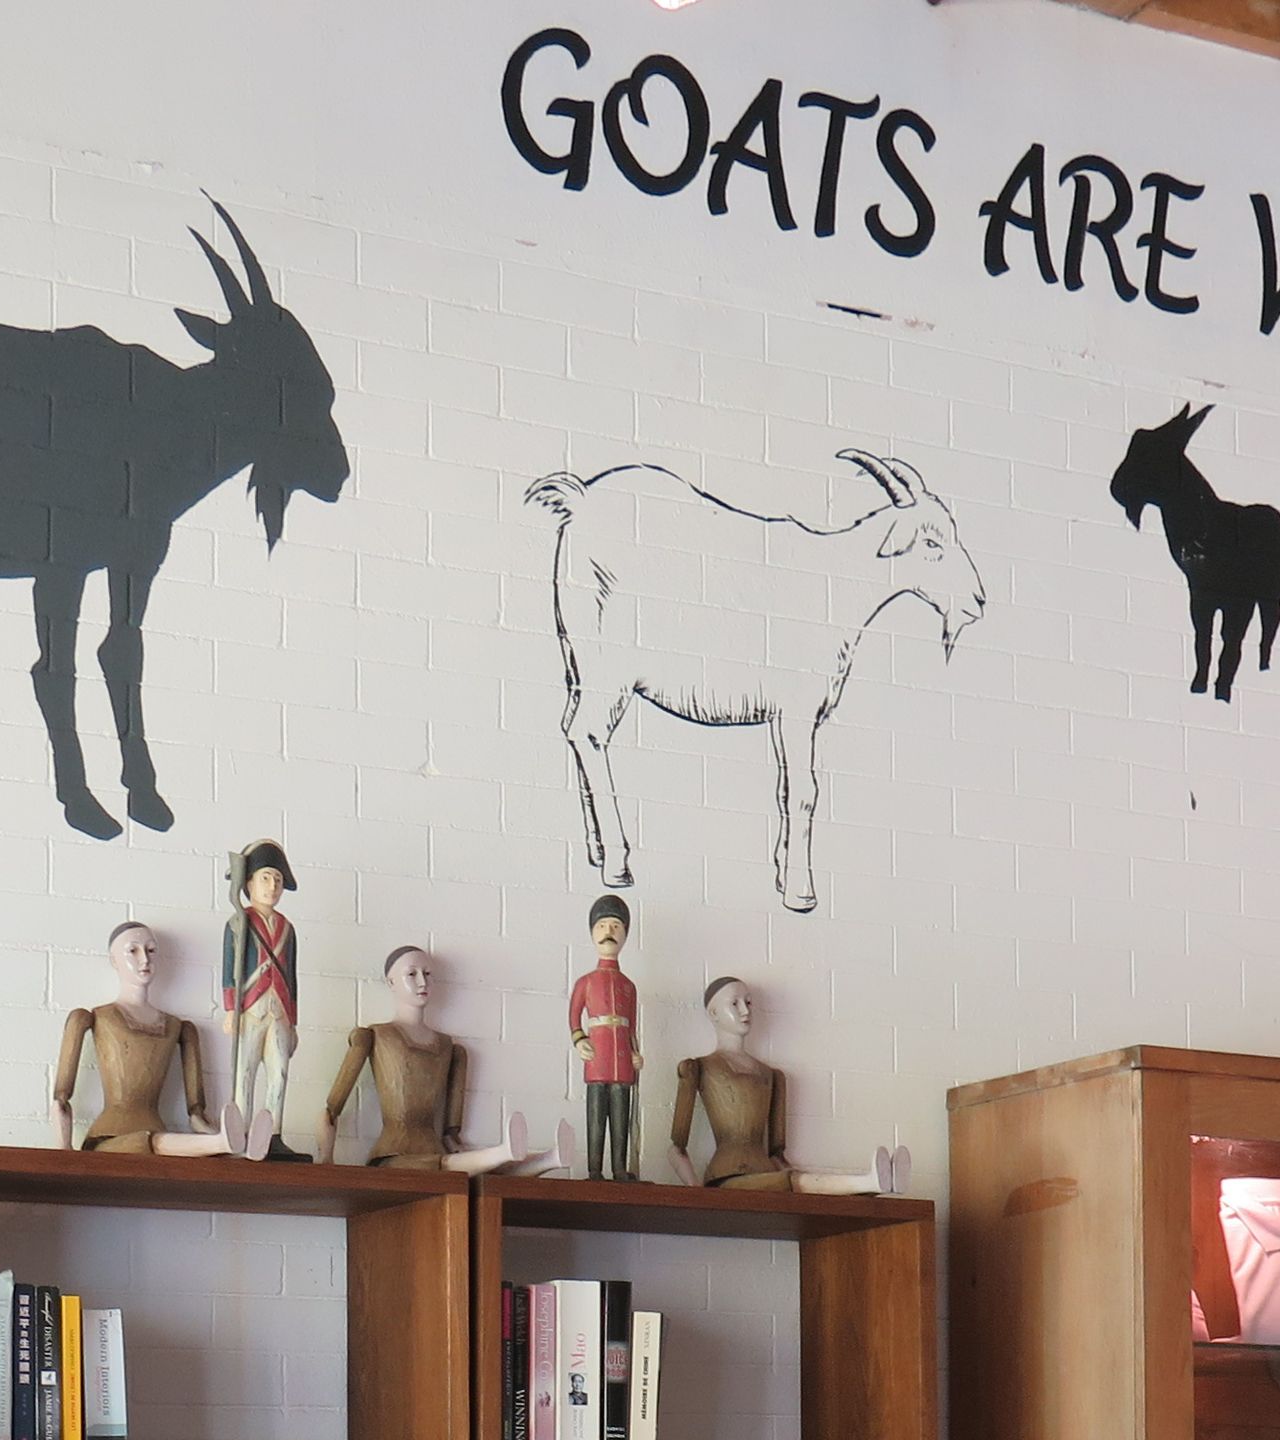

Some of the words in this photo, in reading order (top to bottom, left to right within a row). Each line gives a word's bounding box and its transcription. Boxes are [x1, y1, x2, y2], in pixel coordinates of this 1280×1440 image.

[501, 28, 935, 257] GOATS
[979, 144, 1204, 314] ARE
[44, 1327, 53, 1367] DISASTER
[98, 1319, 109, 1363] Modern
[537, 1290, 553, 1358] Josephine
[570, 1333, 588, 1369] Mao
[101, 1366, 111, 1416] Interiors
